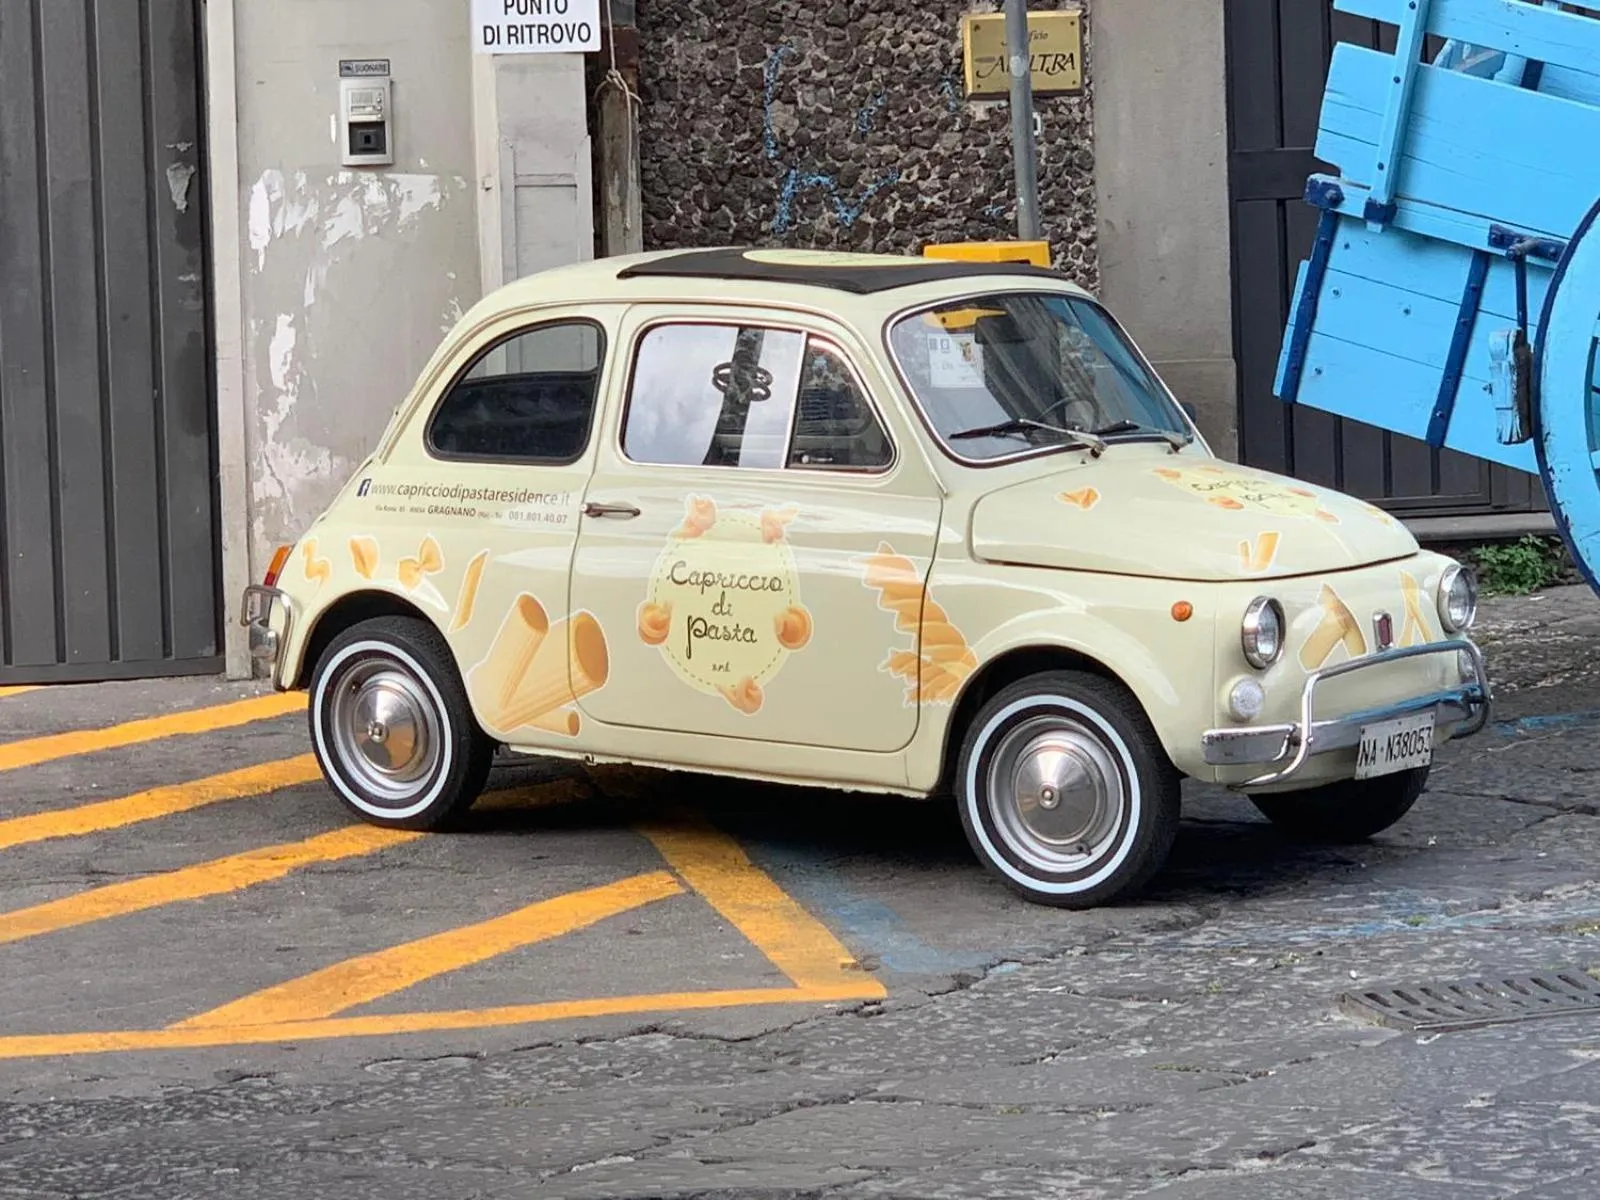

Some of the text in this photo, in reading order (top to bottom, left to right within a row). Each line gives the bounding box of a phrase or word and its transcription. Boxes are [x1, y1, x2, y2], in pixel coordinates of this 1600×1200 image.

[504, 0, 568, 15] PUNTO
[483, 22, 591, 45] DI RITROVO
[976, 52, 1075, 78] ALTRA
[428, 504, 476, 517] GRAGNANO
[666, 560, 783, 595] Capriccio
[712, 591, 733, 616] di
